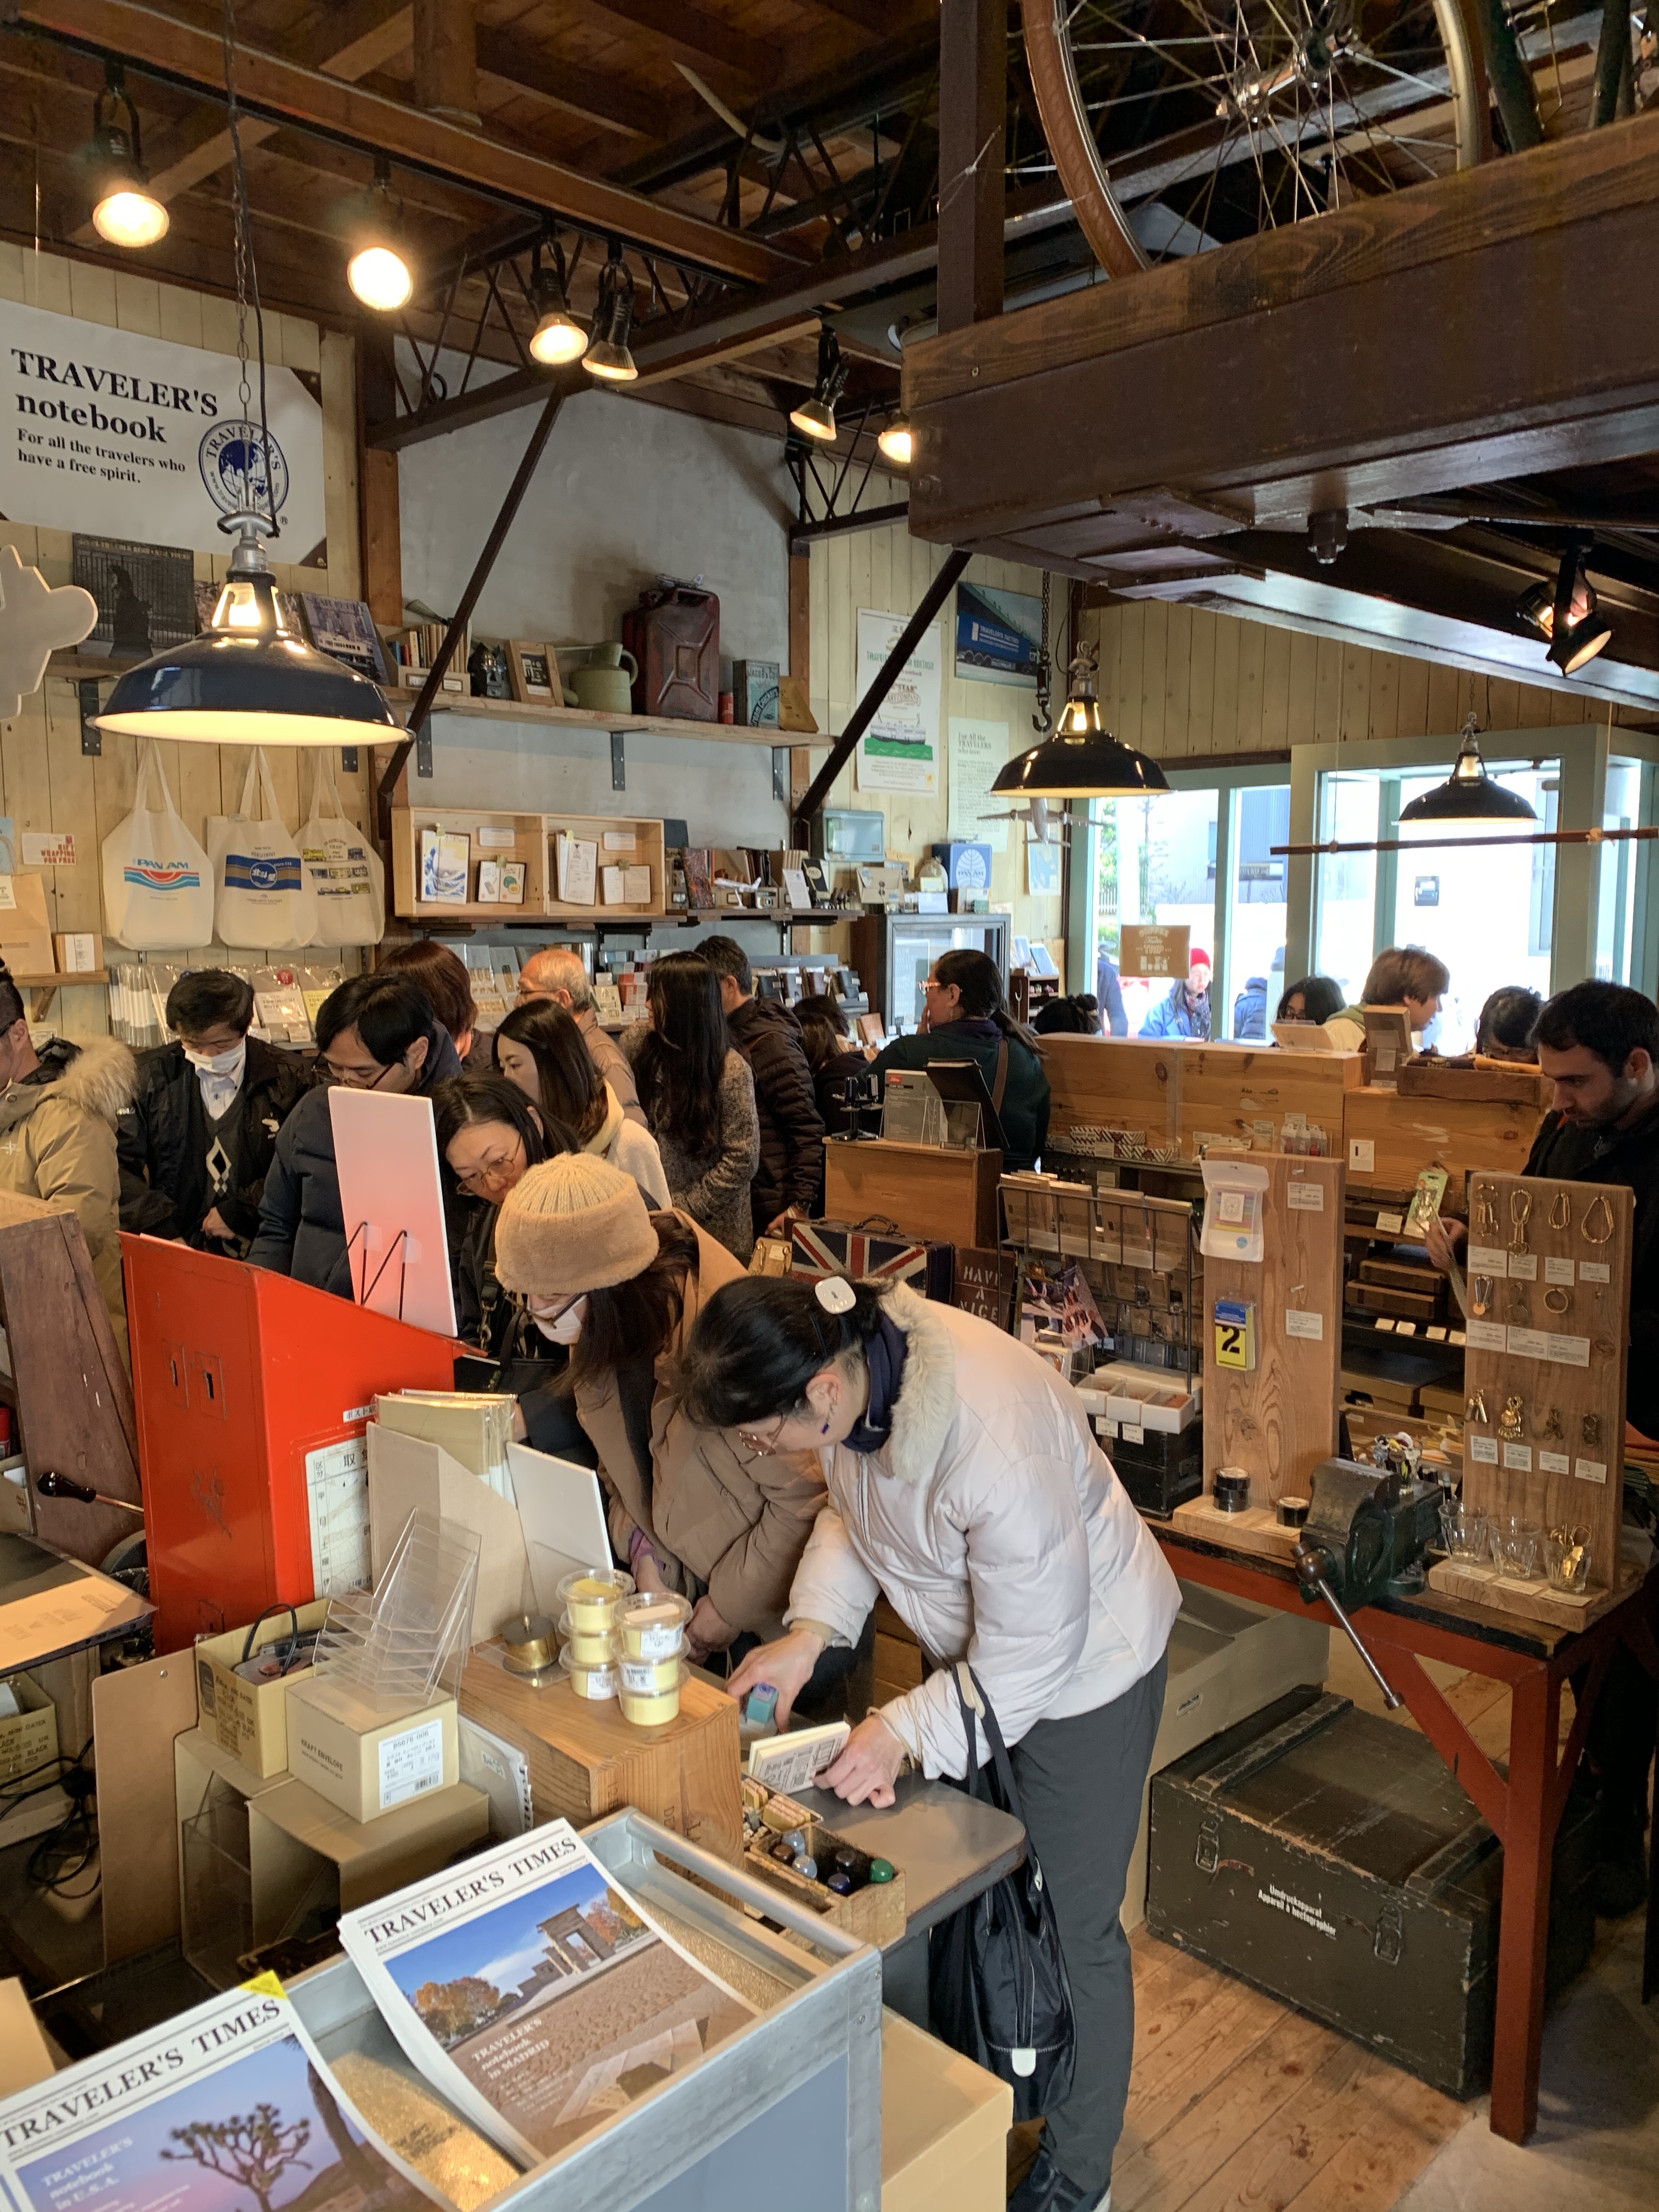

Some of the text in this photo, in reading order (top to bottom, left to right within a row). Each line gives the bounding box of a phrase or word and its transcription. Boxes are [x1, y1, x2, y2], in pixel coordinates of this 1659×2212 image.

[11, 348, 218, 417] TRAVELER'S
[15, 393, 167, 443] notebook
[16, 427, 185, 472] For all the travelers who
[18, 449, 141, 483] have a free spirit.
[138, 858, 189, 870] PAN AM
[975, 1285, 984, 1301] A
[1222, 1327, 1240, 1354] 2
[301, 1738, 317, 1754] KRAFT
[318, 1748, 343, 1772] ENVELOPE
[364, 1870, 505, 1944] TRAVELER'S
[508, 1837, 577, 1878] TIMES
[1258, 1889, 1285, 1911] Appareil
[1269, 1883, 1322, 1919] Umdruckapparat
[471, 2018, 543, 2063] TRAVELER'S
[481, 2038, 531, 2072] notebook
[488, 2039, 550, 2080] in MADRID
[0, 1999, 280, 2149] TRAVELER'S TIMES
[41, 2137, 133, 2187] TRAVELER'S
